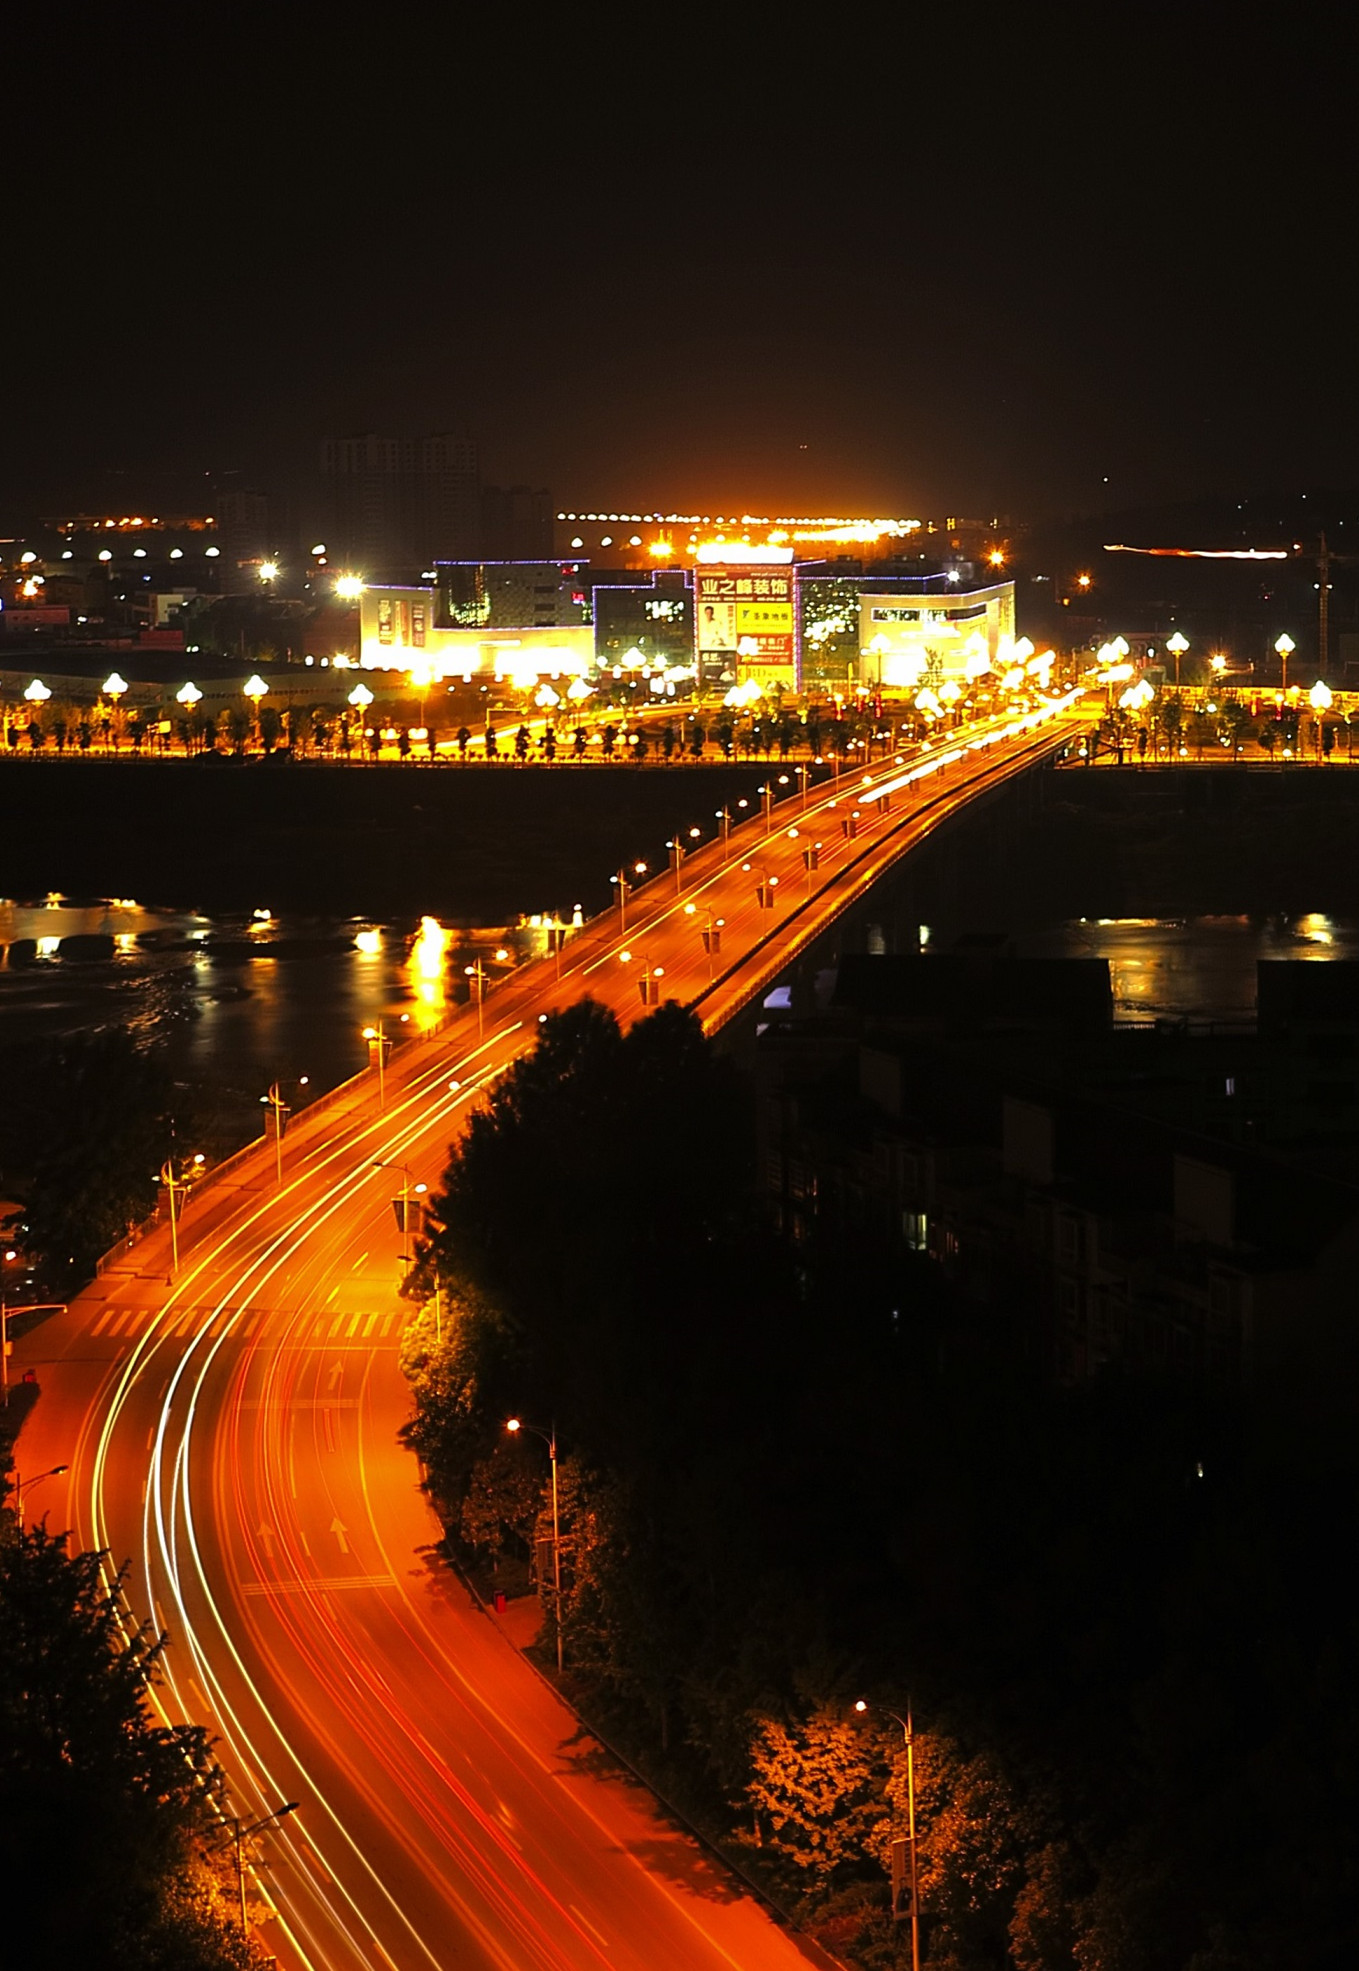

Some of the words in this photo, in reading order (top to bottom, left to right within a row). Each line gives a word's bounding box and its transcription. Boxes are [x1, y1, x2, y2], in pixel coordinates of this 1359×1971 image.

[702, 579, 788, 595] 业之峰装饰
